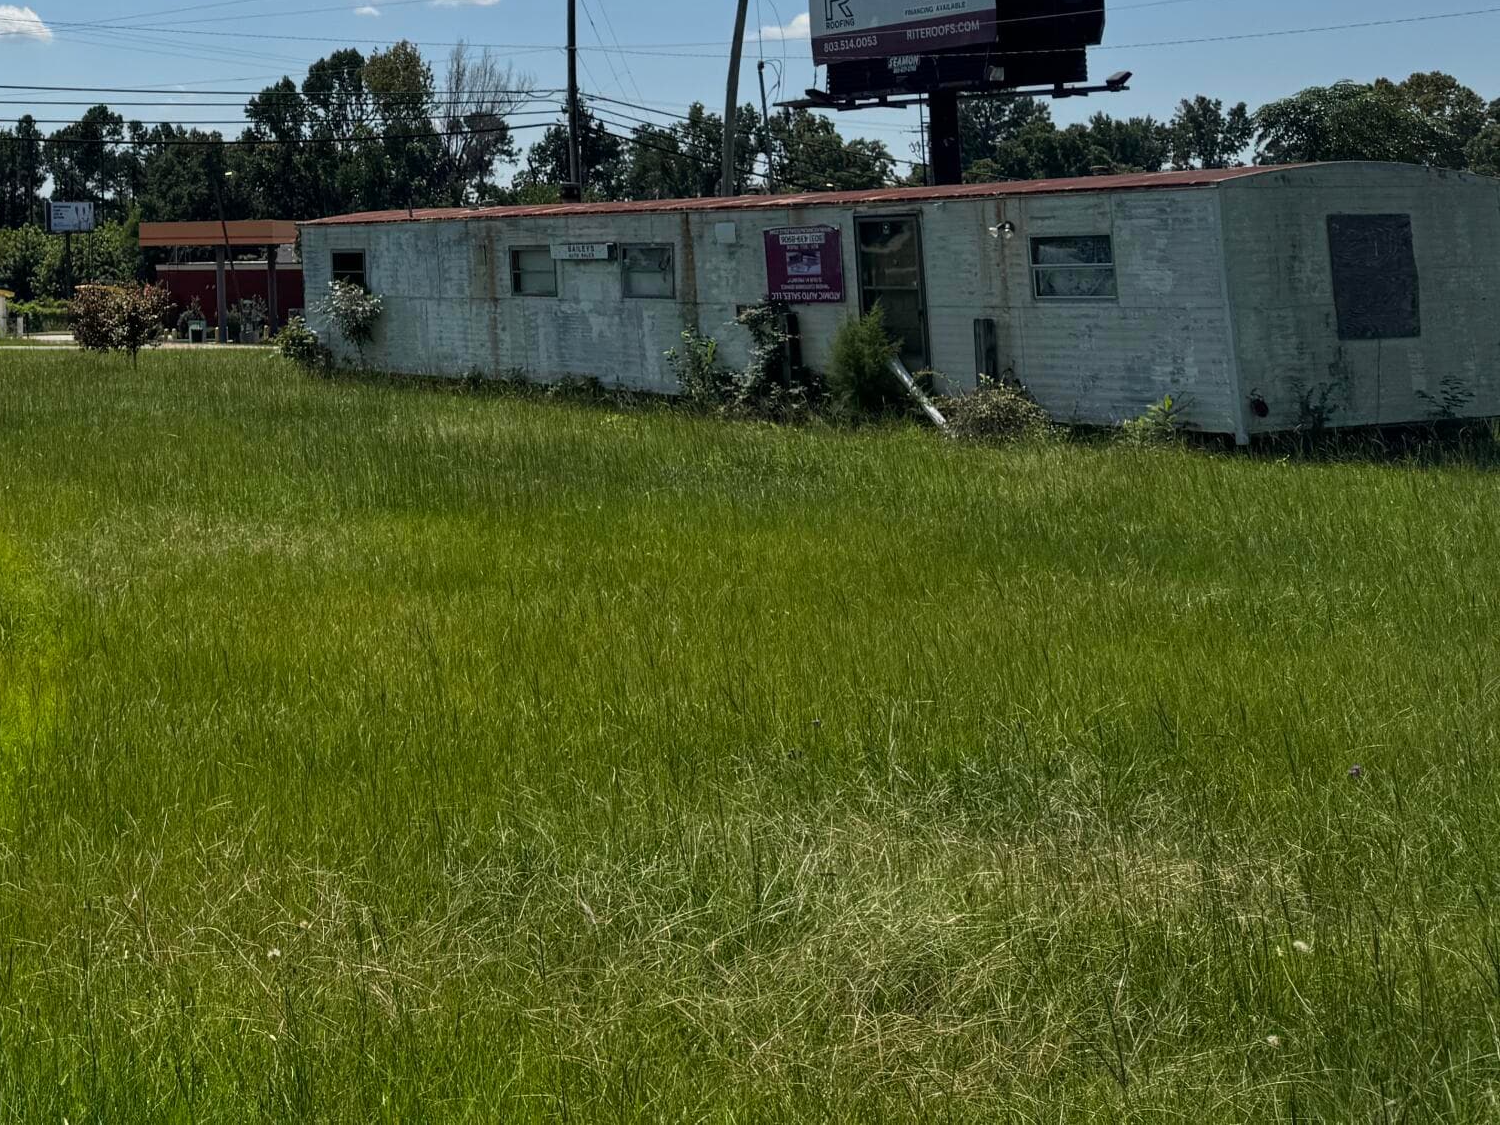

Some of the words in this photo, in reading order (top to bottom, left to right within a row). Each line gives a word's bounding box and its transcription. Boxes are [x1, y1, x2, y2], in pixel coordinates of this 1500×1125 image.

[935, 1, 966, 12] AVAILABLE
[825, 18, 855, 30] ROOFING
[823, 36, 878, 53] 803.514.0053
[906, 20, 980, 41] RITEROOFS.COM
[771, 292, 781, 300] LLC
[802, 291, 818, 300] AUTO
[818, 291, 841, 300] ATOMIC
